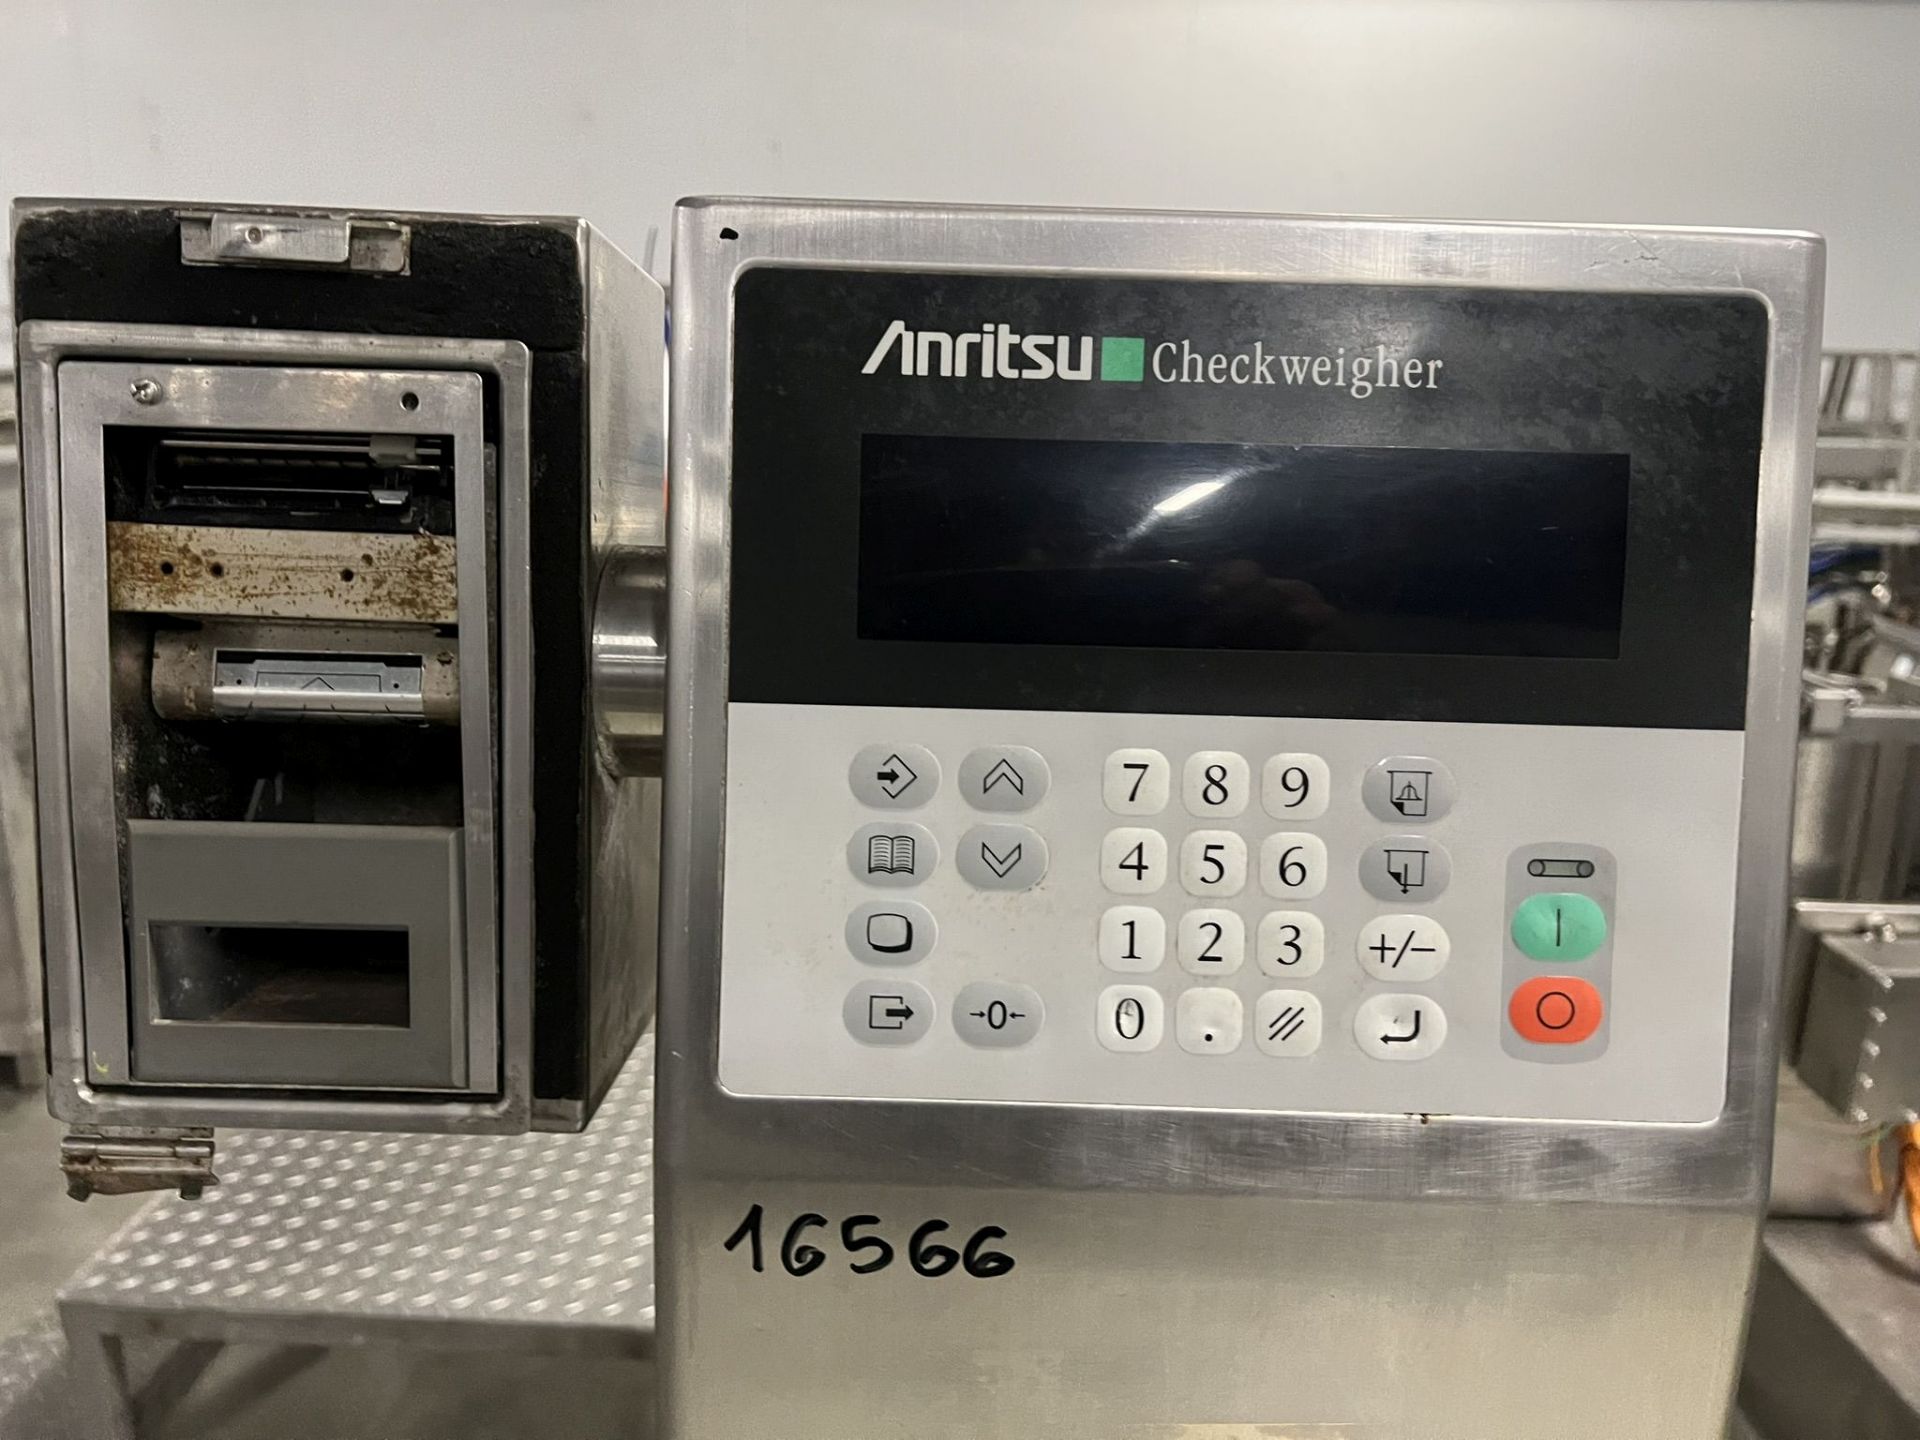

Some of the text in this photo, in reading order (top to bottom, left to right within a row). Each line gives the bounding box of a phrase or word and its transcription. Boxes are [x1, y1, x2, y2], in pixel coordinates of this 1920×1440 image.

[861, 320, 1444, 398] Anritsu Checkweigher
[1123, 763, 1309, 808] 7 8 9
[1118, 841, 1307, 887] 4 5 6
[1120, 919, 1302, 966] 1 2 3
[1115, 998, 1145, 1040] 0
[723, 1203, 1016, 1279] 16566
